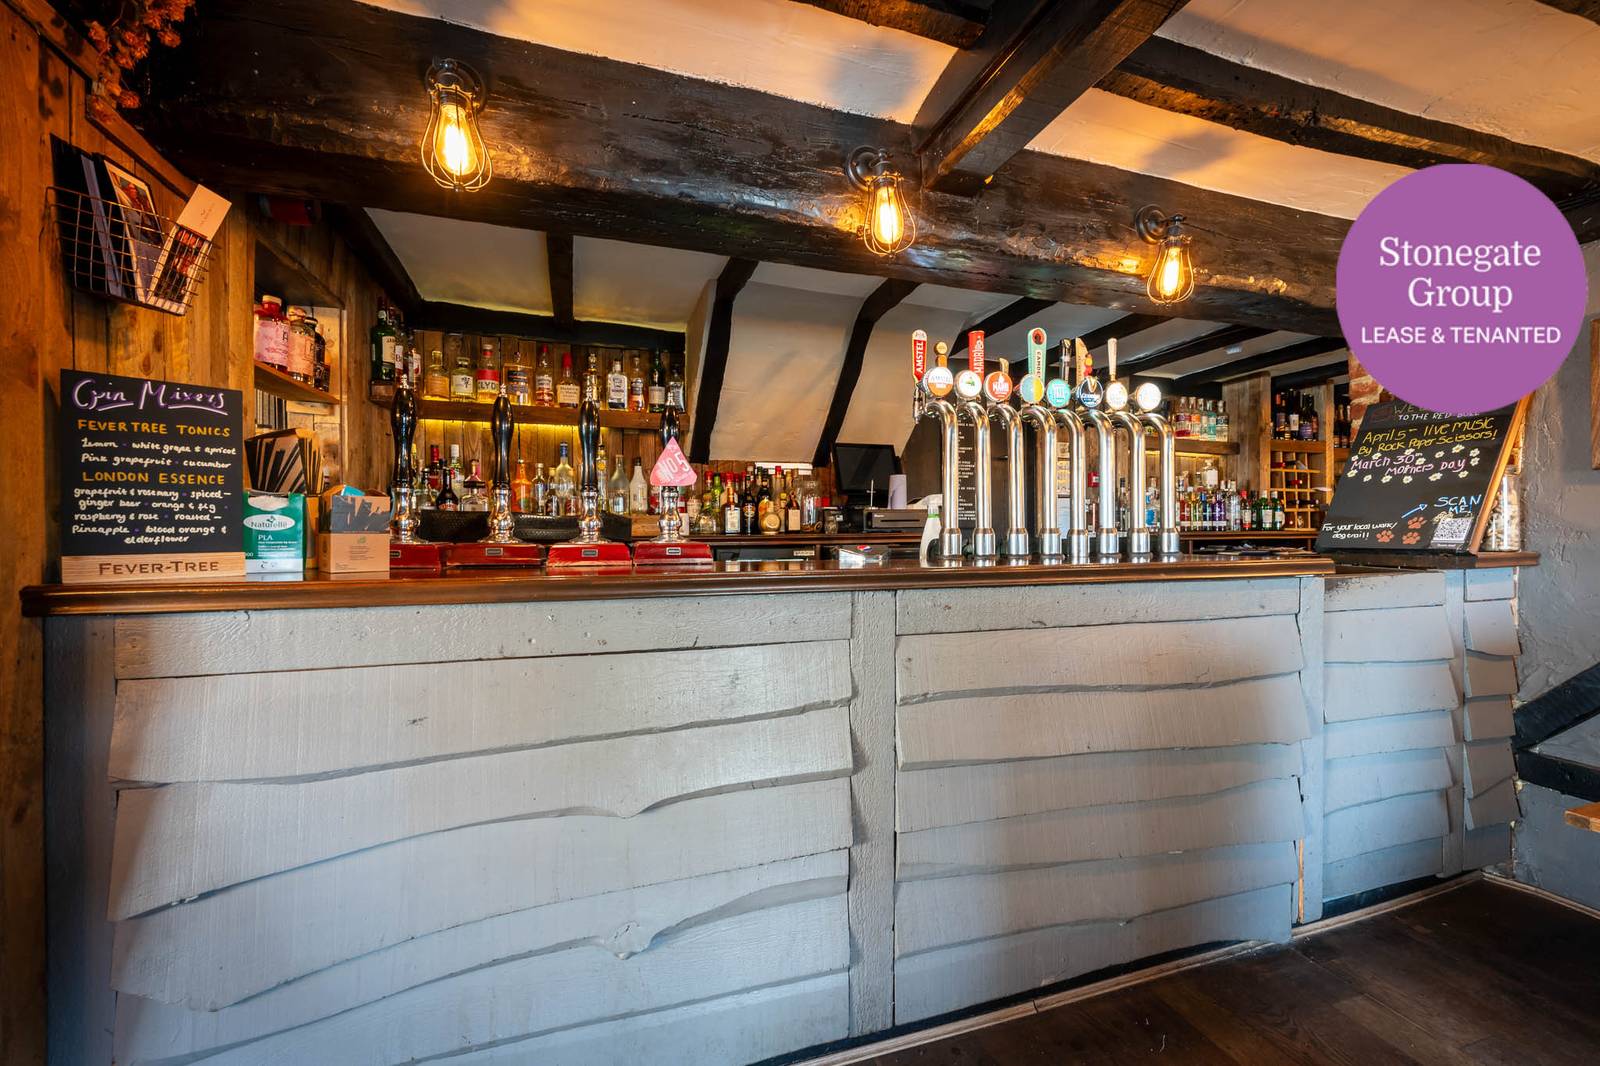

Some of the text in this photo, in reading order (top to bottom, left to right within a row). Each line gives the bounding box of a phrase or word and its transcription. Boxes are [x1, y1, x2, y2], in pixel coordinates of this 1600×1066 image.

[915, 341, 924, 374] AMSTEL
[74, 379, 224, 410] Gin Mixers
[1411, 413, 1430, 421] THE
[77, 419, 231, 437] FEVER TREE TONICS
[1363, 429, 1396, 445] April
[1396, 430, 1407, 441] 5
[132, 442, 160, 450] white
[163, 445, 191, 454] grape
[205, 446, 236, 455] apricot
[1358, 445, 1374, 456] By
[81, 453, 232, 469] Pink grapefruit cucumber
[674, 452, 690, 472] 5
[1351, 456, 1391, 471] March
[82, 471, 225, 485] LONDON ESSENCE
[74, 487, 127, 498] grapefruit
[137, 489, 179, 501] rosemary
[190, 490, 222, 499] spiced
[1433, 494, 1482, 507] SCAN
[79, 498, 114, 511] ginger
[151, 501, 184, 511] orange
[197, 502, 216, 514] fig
[74, 512, 126, 524] raspberry
[138, 513, 159, 521] rose
[174, 514, 211, 522] roasted
[251, 520, 288, 528] Naturelle
[72, 524, 130, 536] Pineapple
[145, 526, 175, 534] blood
[178, 525, 216, 536] orange
[1321, 523, 1336, 531] For
[1333, 524, 1354, 534] your
[123, 536, 189, 545] elderflower
[99, 561, 220, 576] FEVER-TREE
